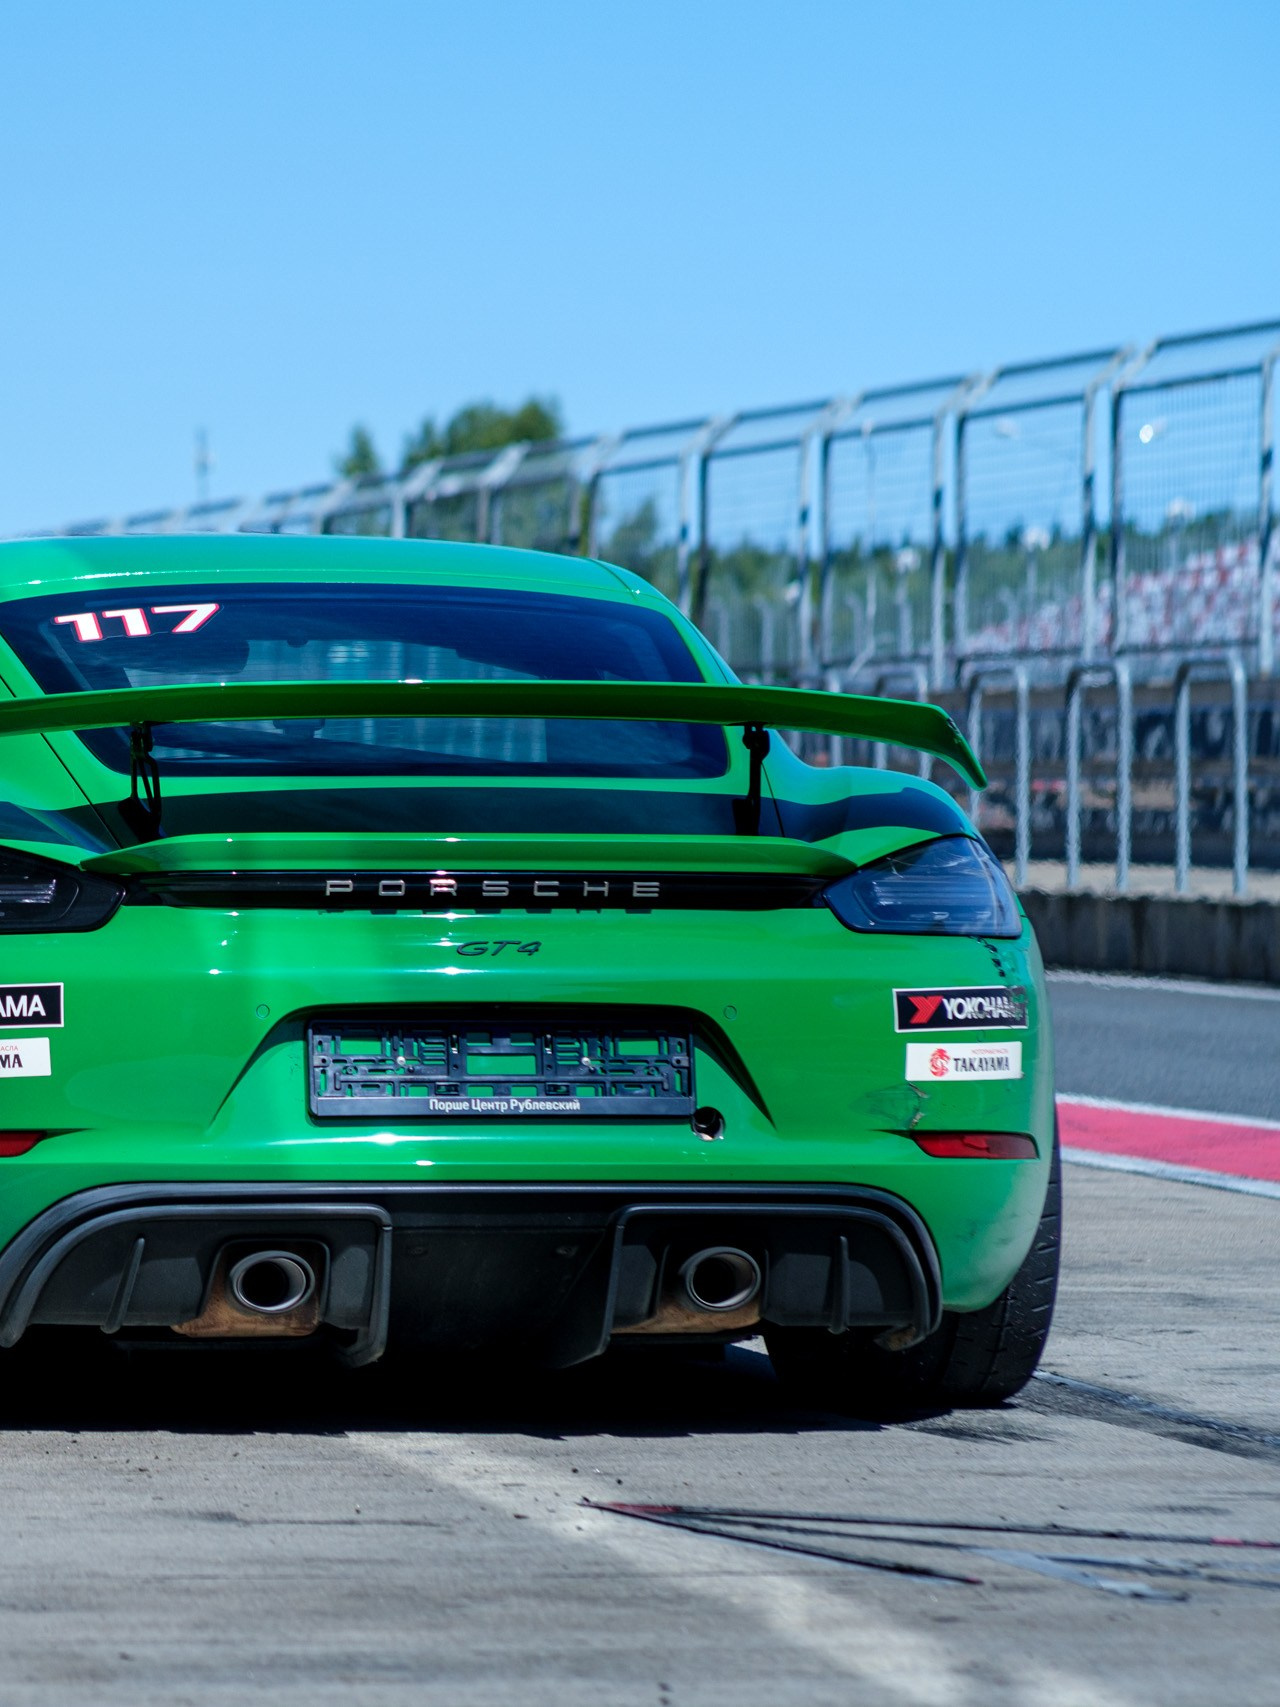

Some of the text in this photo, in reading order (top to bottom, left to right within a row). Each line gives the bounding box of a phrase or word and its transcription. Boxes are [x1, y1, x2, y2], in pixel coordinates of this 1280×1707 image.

[54, 603, 220, 642] 117
[325, 880, 660, 897] PORSCHE
[456, 941, 542, 957] GT4
[953, 1056, 1010, 1073] TAKAYAMA
[429, 1098, 581, 1113] Порше Центр Рублевский
